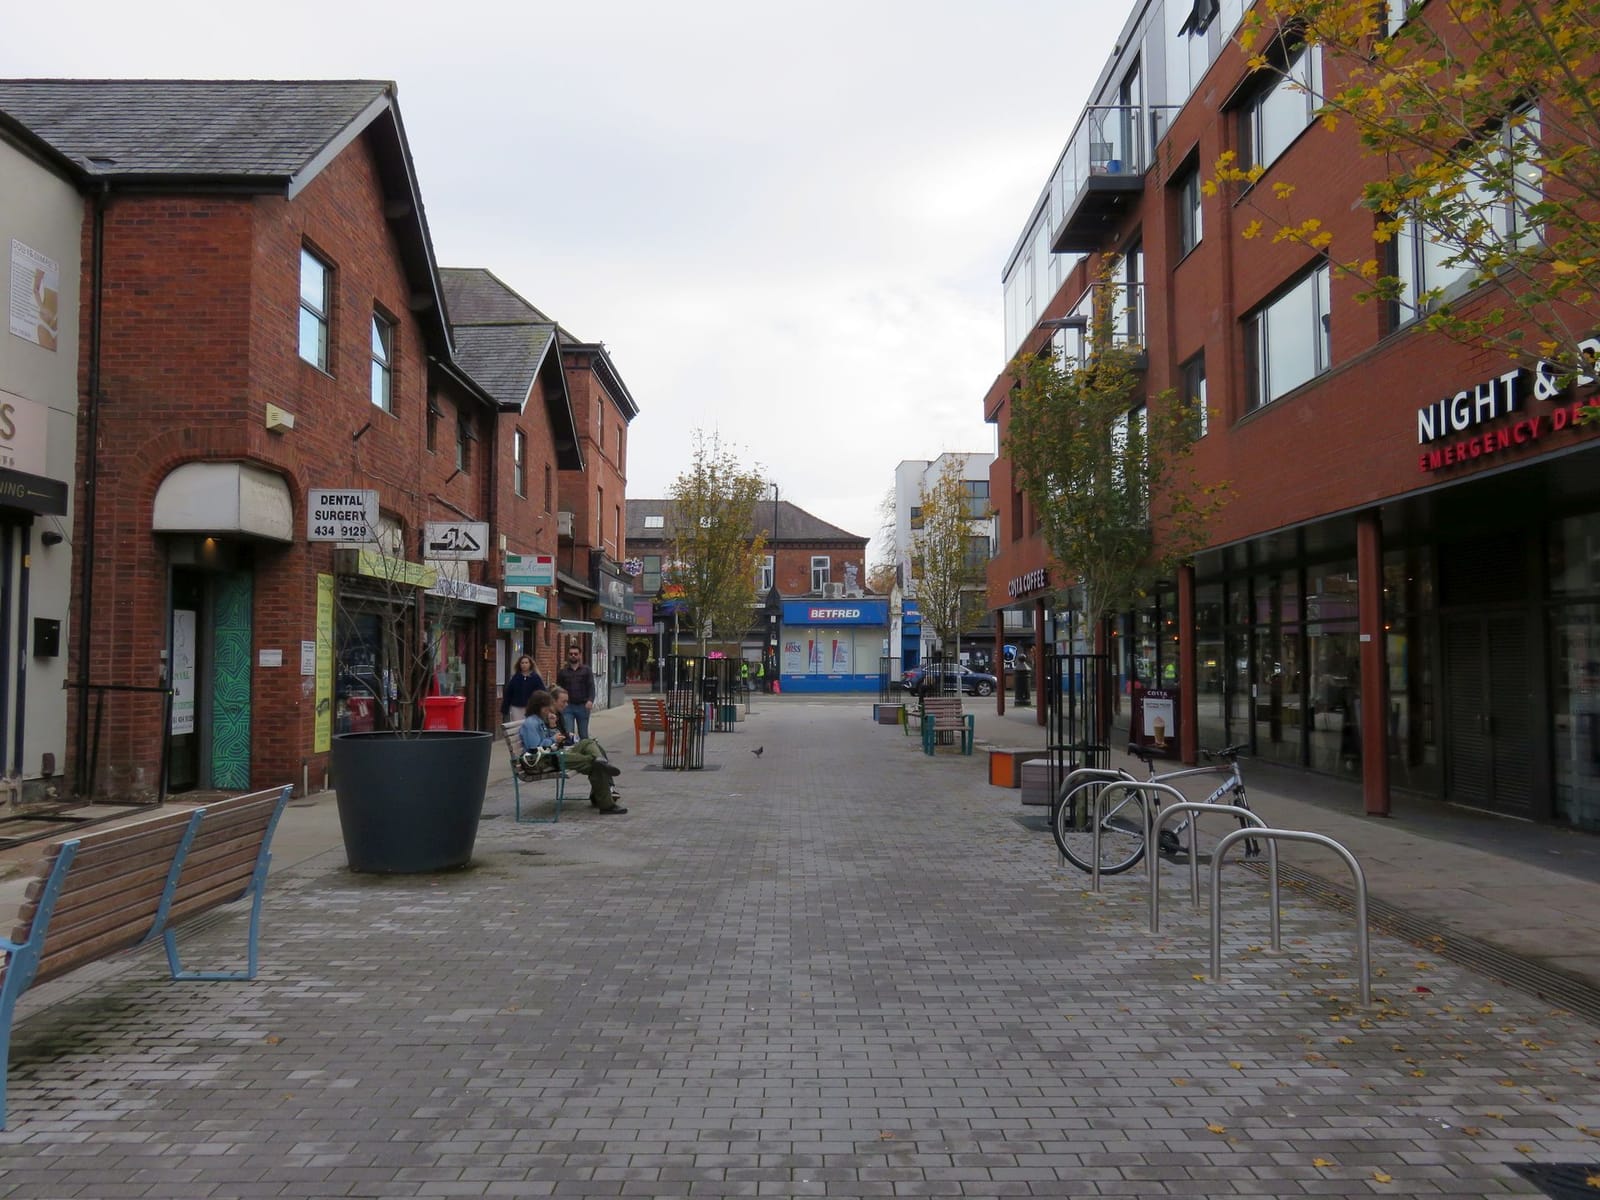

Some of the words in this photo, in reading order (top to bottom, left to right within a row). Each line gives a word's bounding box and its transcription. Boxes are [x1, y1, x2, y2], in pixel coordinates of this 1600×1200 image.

[1418, 368, 1520, 444] NIGHT
[1534, 360, 1560, 401] &
[1418, 416, 1541, 472] EMERGENCY
[320, 495, 363, 505] DENTAL
[315, 511, 366, 521] SURGERY
[315, 527, 335, 536] 434
[341, 527, 366, 536] 9129
[1008, 577, 1023, 597] COSTA
[1023, 569, 1044, 591] COFFEE
[810, 608, 861, 619] BETFRED
